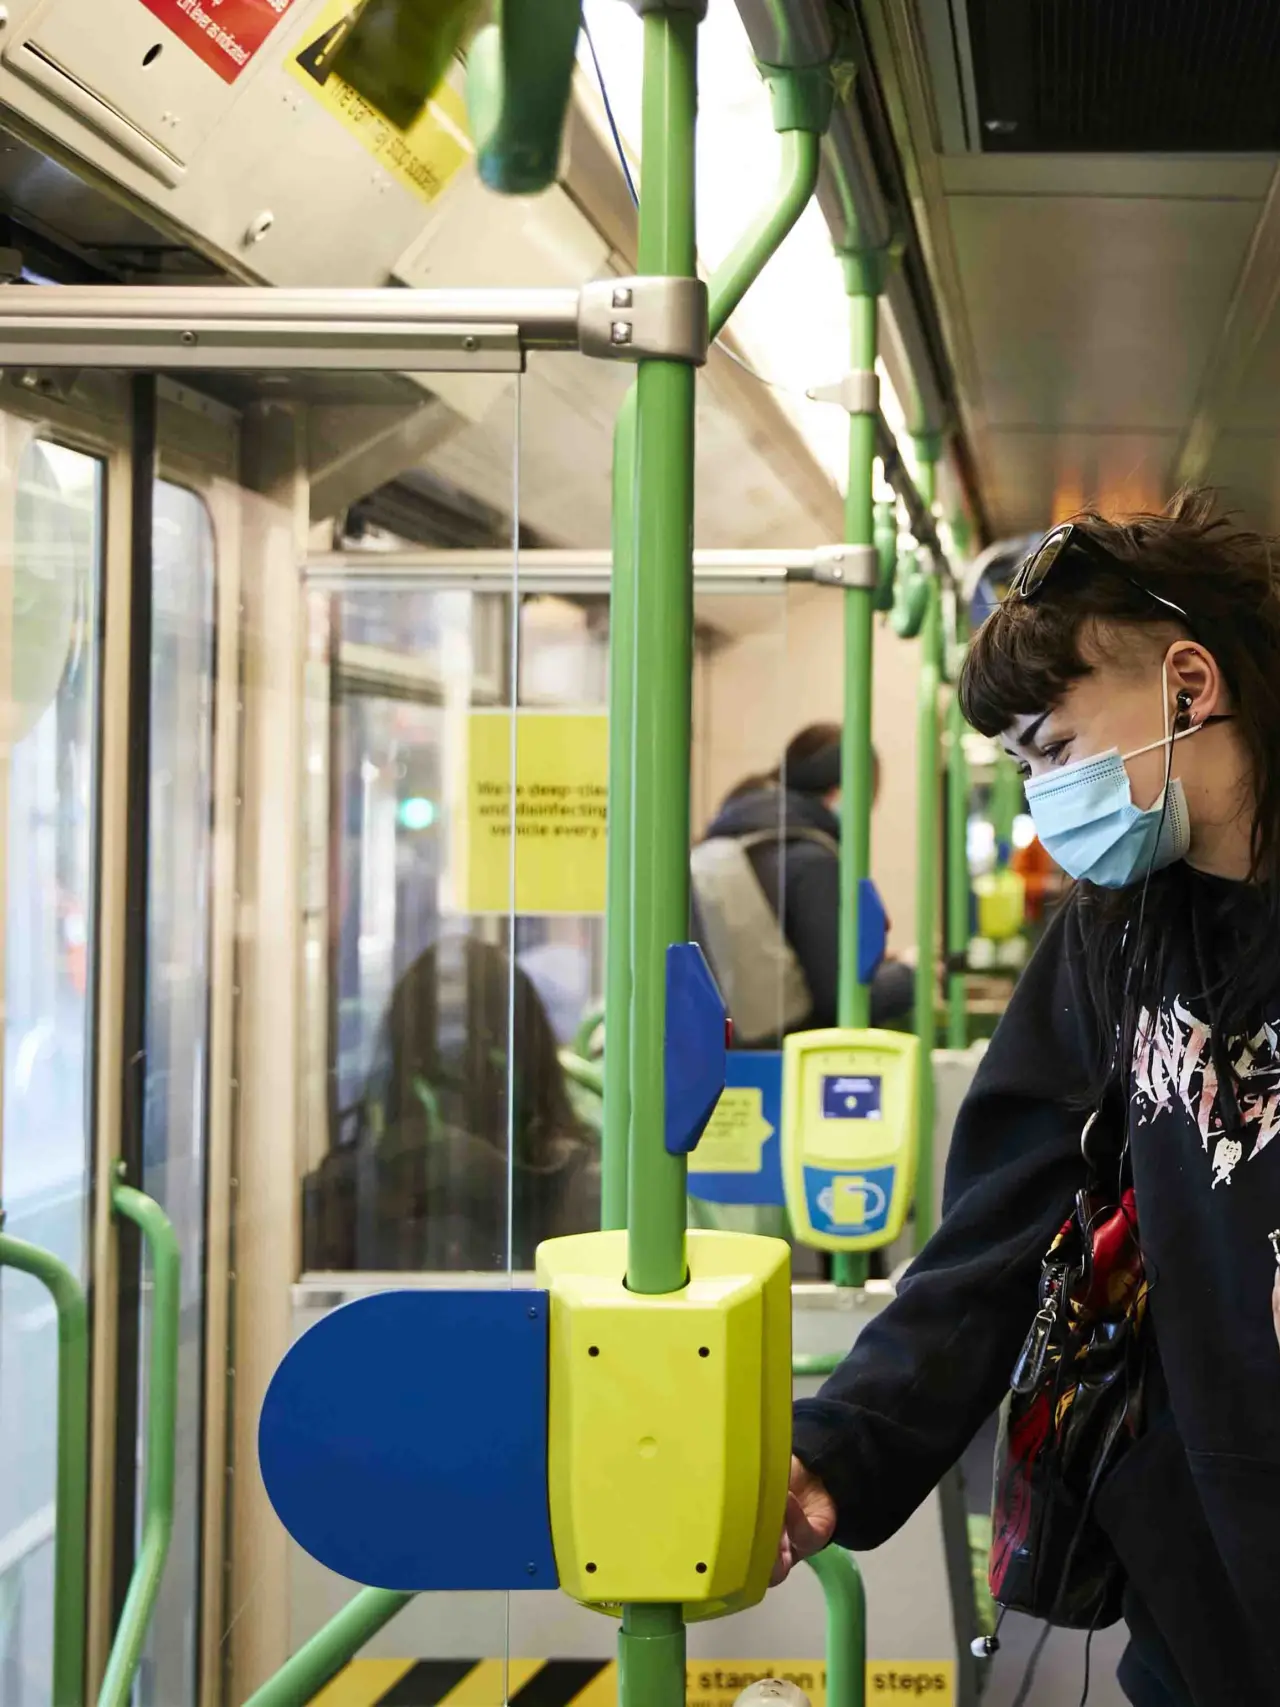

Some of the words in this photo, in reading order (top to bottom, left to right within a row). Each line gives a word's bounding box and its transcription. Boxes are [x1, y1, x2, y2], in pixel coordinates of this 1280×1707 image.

[215, 26, 252, 66] indicated
[478, 803, 513, 817] and
[552, 825, 600, 840] every
[874, 1671, 947, 1696] steps
